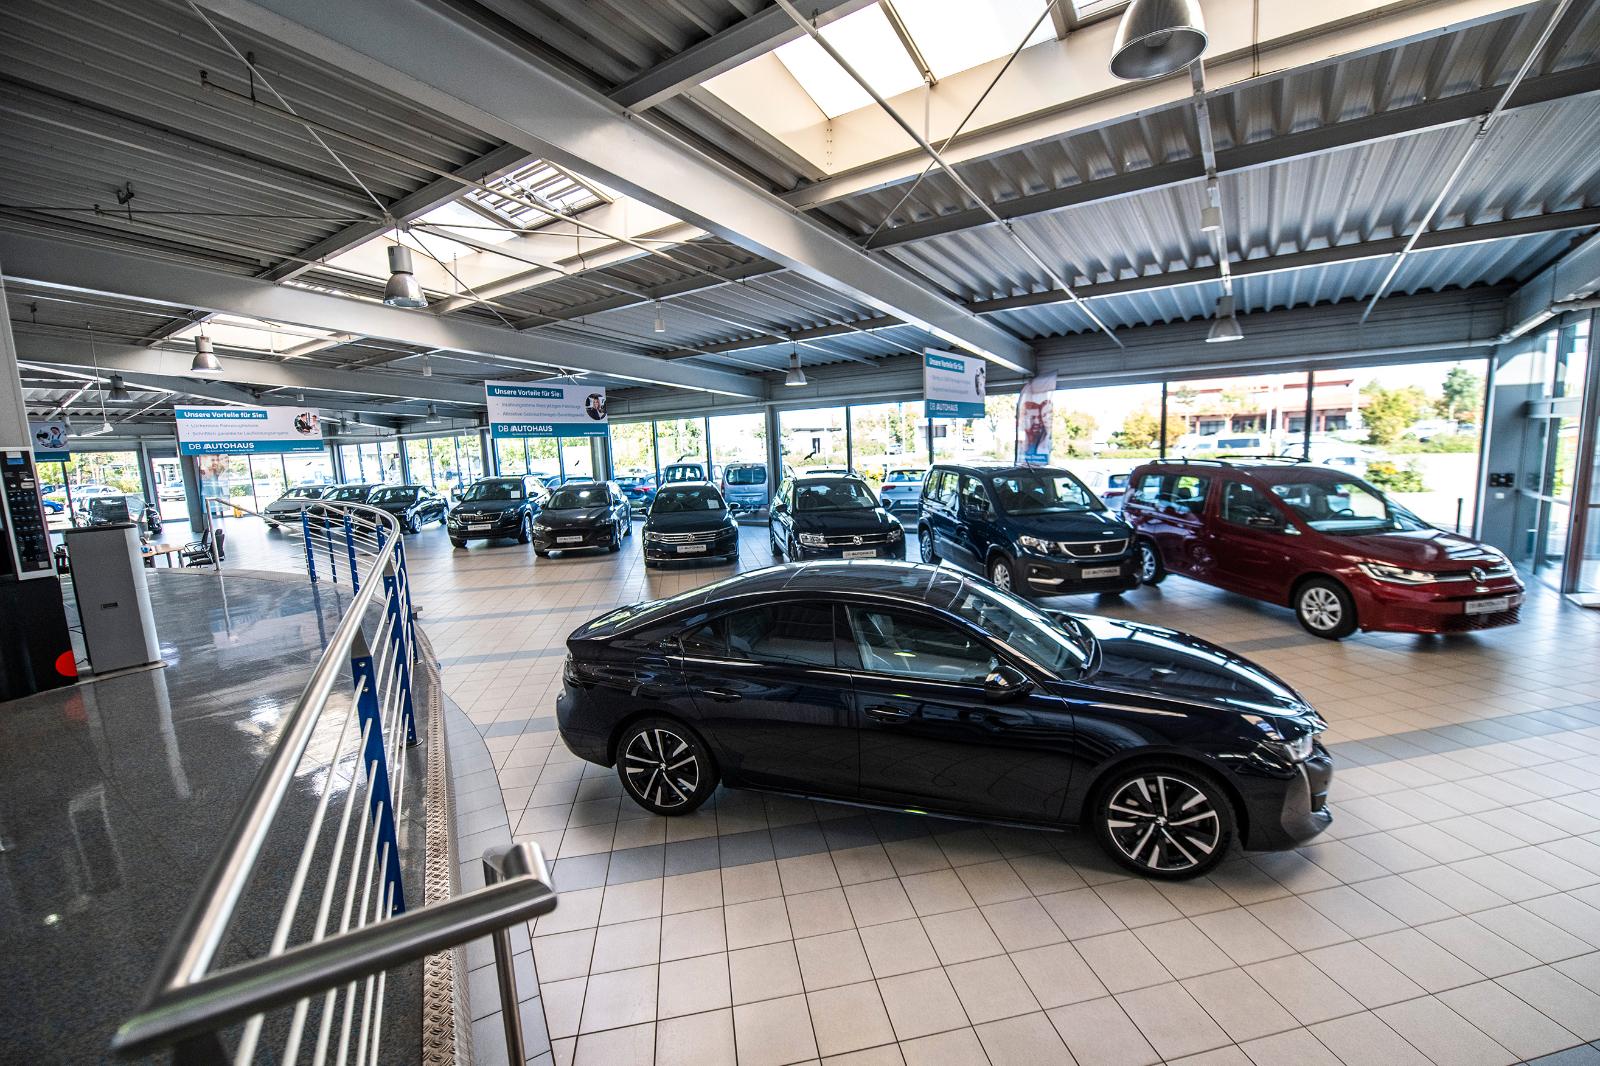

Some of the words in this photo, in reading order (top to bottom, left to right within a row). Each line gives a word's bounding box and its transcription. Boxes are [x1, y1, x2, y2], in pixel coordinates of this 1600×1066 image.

[494, 388, 517, 396] Unsere
[517, 389, 541, 397] Vorteile
[551, 390, 562, 398] Sie:
[497, 425, 509, 433] DB
[203, 442, 255, 450] AUTOHAUS
